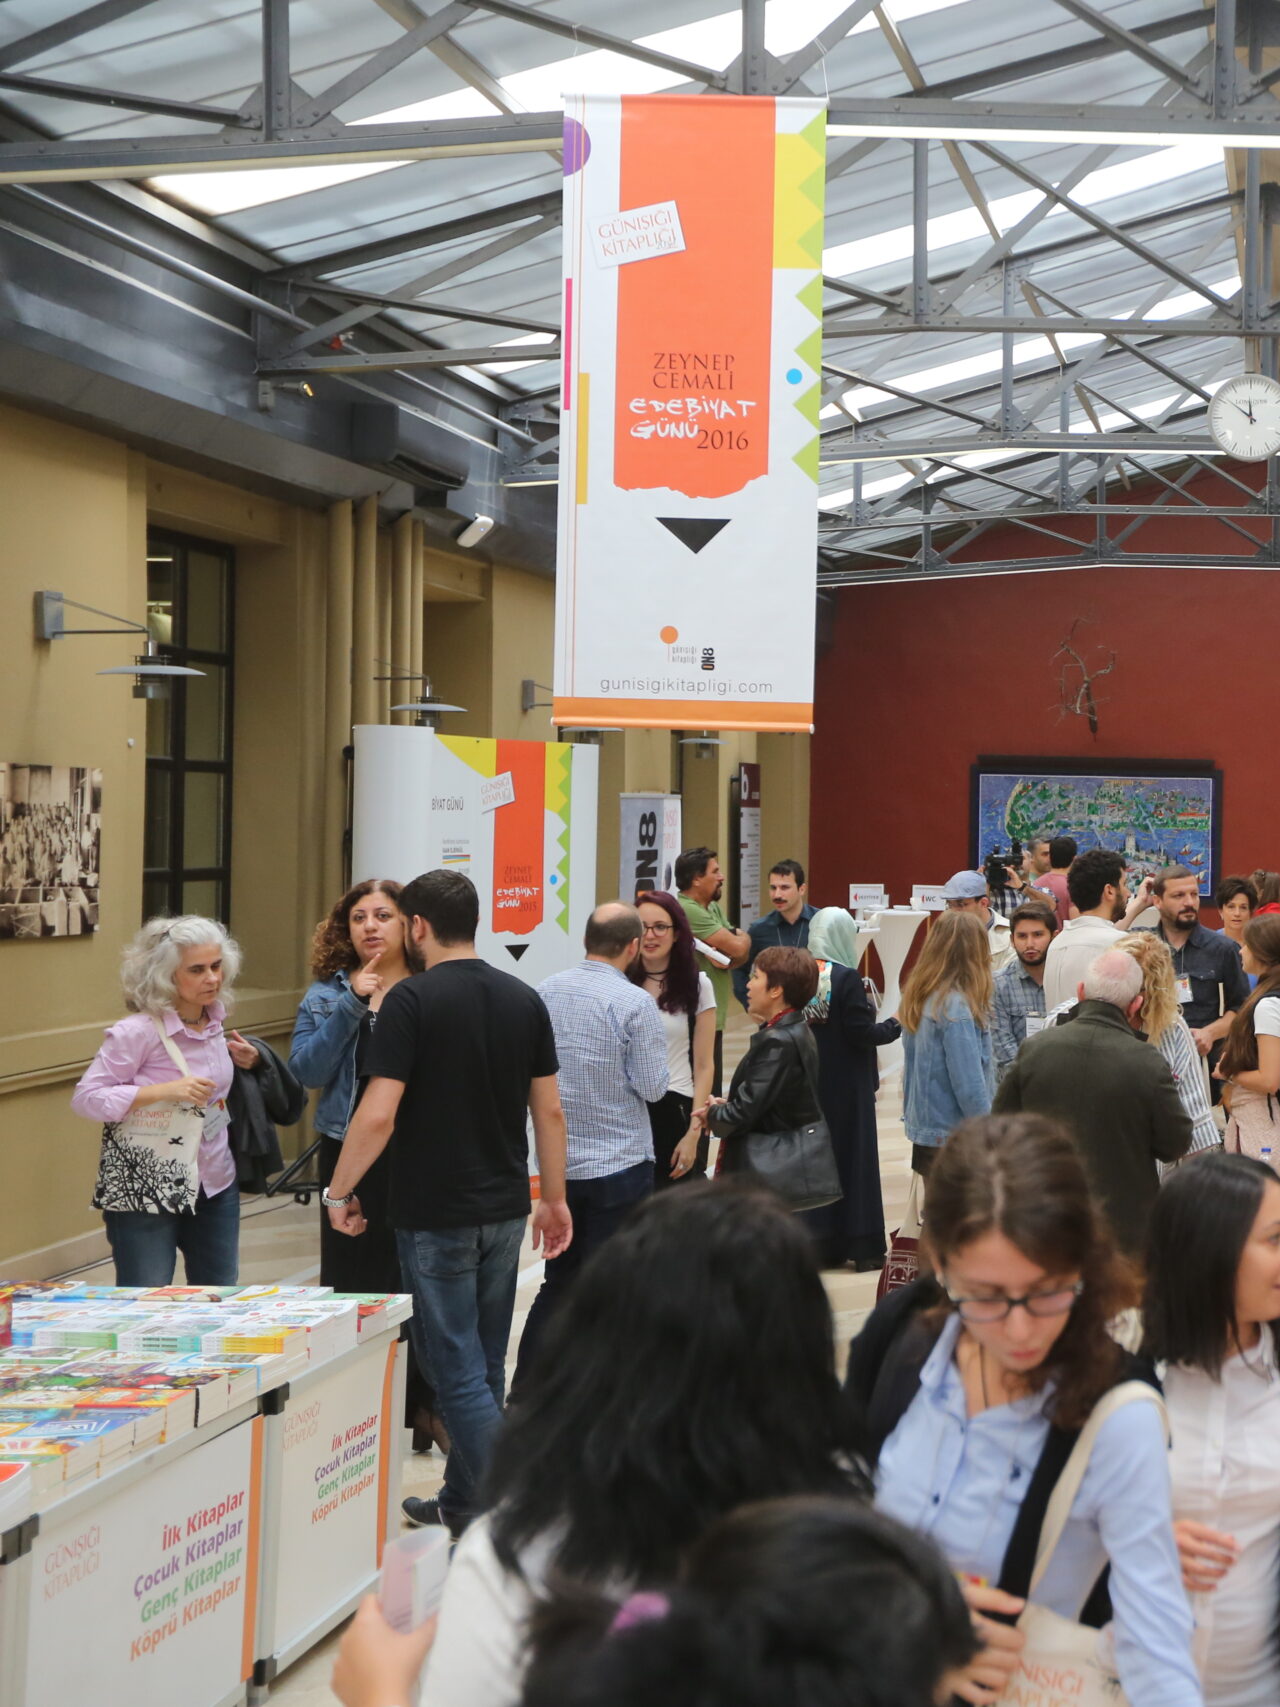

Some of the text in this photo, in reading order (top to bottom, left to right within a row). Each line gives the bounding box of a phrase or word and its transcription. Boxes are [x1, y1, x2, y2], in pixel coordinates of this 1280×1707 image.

[653, 353, 735, 371] ZEYNEP
[653, 371, 733, 391] CEMALİ
[629, 395, 756, 420] EDEBİYAT
[629, 418, 749, 450] GÜNÜ 2016
[701, 648, 715, 671] ON8
[600, 678, 773, 695] gunisigikitapligi.com
[447, 796, 464, 811] GÜNÜ
[496, 886, 540, 897] EDEBİYAT
[331, 1415, 378, 1452] İlk Kitaplar
[314, 1434, 377, 1484] Çocuk Kitaplar
[317, 1453, 376, 1500] Genç Kitaplar
[311, 1473, 375, 1524] Köprü Kitaplar
[162, 1491, 245, 1551] İlk Kitaplar
[134, 1519, 244, 1600] Çocuk Kitaplar
[140, 1547, 242, 1623] Genç Kitaplar
[129, 1576, 241, 1662] Köprü Kitaplar
